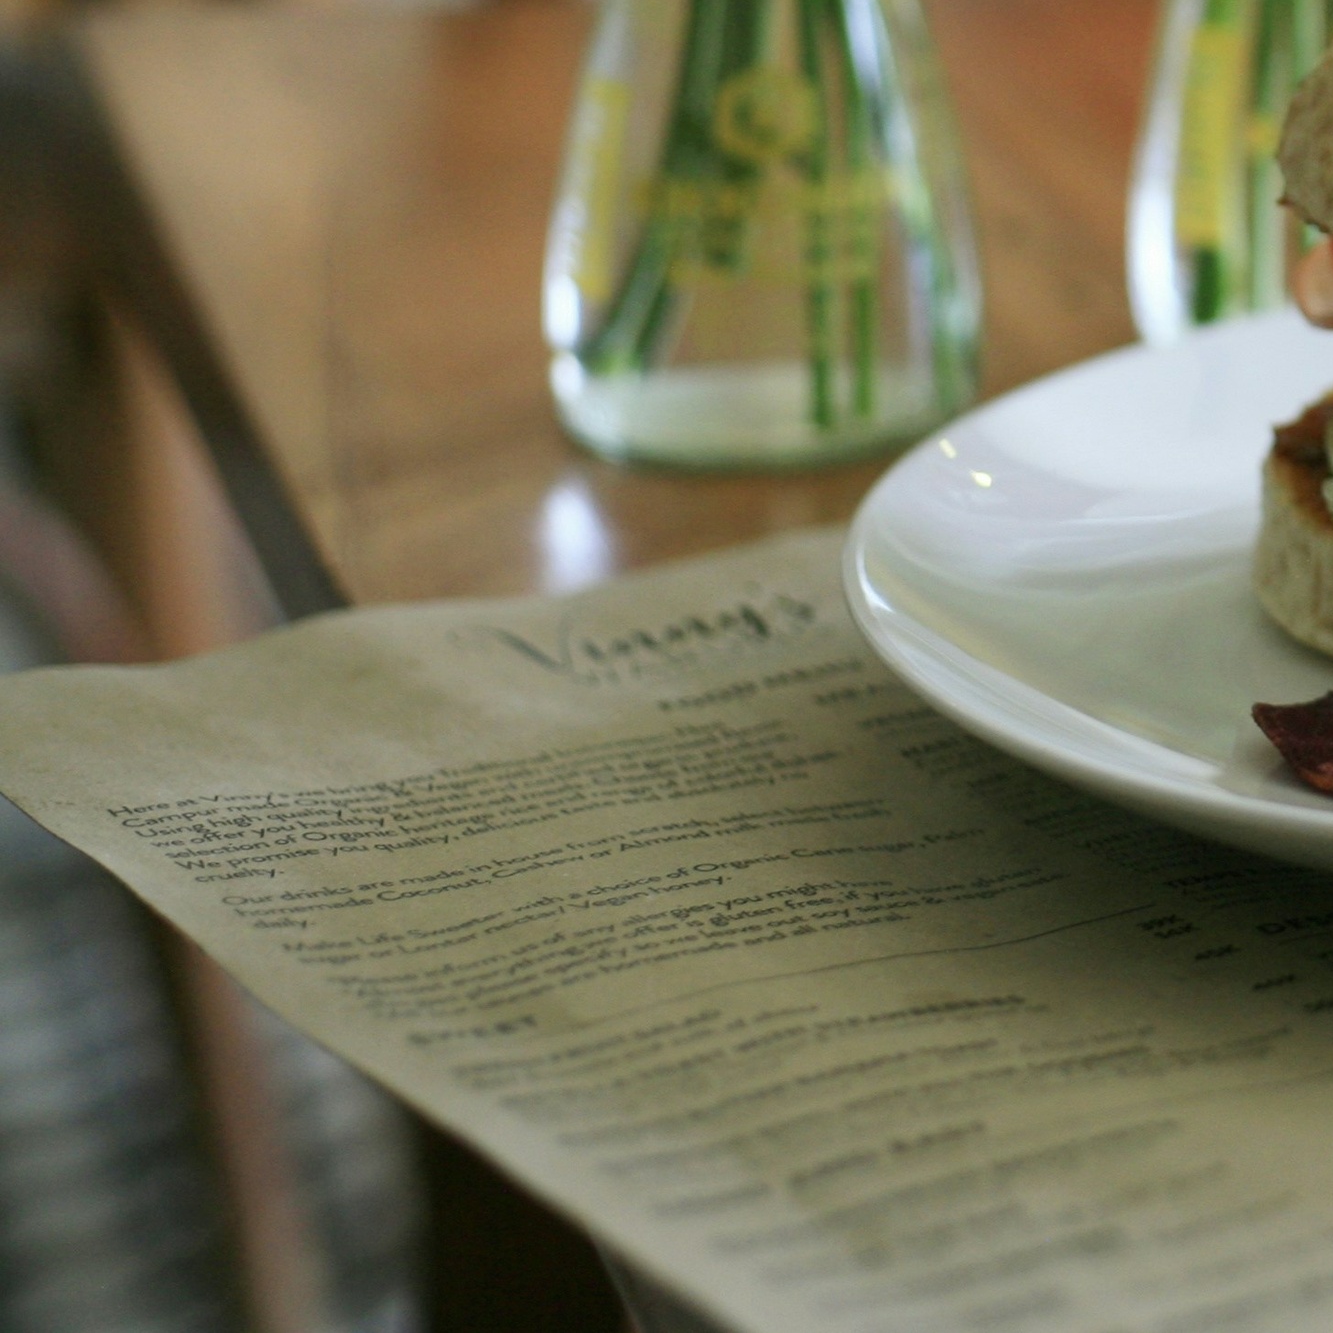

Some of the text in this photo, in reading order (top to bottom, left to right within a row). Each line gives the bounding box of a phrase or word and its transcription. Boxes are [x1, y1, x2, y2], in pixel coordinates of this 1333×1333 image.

[105, 802, 170, 818] Here
[175, 797, 199, 808] at
[197, 790, 290, 809] Vinny's
[120, 807, 218, 828] Campur
[225, 800, 290, 812] made
[133, 822, 204, 838] Using
[205, 813, 262, 832] high
[266, 807, 342, 823] quality
[149, 839, 185, 848] we
[189, 830, 245, 844] offer
[250, 824, 295, 839] you
[295, 810, 385, 836] healthy
[163, 840, 271, 859] selection
[273, 833, 297, 846] of
[300, 821, 393, 842] Organic
[173, 858, 221, 871] We
[225, 848, 320, 868] promise
[323, 844, 369, 857] you
[373, 833, 460, 853] quality,
[220, 894, 273, 906] Our
[278, 885, 354, 901] drinks
[357, 880, 394, 891] are
[398, 869, 465, 885] made
[467, 863, 492, 873] in
[490, 847, 563, 867] house
[564, 833, 626, 851] from
[193, 867, 285, 883] cruelty.
[232, 896, 374, 918] homemade
[375, 877, 492, 902] Coconut,
[490, 854, 584, 879] Cashew
[588, 848, 612, 859] or
[619, 828, 711, 852] Almond
[355, 931, 405, 945] Life
[405, 910, 505, 939] Sweeter
[510, 895, 564, 913] with
[567, 891, 582, 900] a
[585, 875, 662, 896] choice
[665, 866, 689, 879] of
[691, 852, 790, 873] Organic
[789, 846, 855, 858] Cane
[622, 922, 678, 939] offer
[685, 919, 705, 928] is
[708, 906, 783, 927] gluten
[783, 890, 844, 910] free,
[838, 889, 860, 903] if
[864, 889, 909, 901] you
[251, 916, 316, 930] daily.
[368, 948, 392, 959] or
[396, 932, 477, 955] Lontar
[566, 890, 649, 910] Vegan
[646, 874, 732, 895] honey.
[510, 942, 539, 956] us
[541, 931, 566, 945] of
[572, 923, 615, 938] any
[621, 902, 715, 927] allergies
[715, 894, 763, 911] you
[765, 879, 837, 899] might
[833, 878, 893, 895] have
[633, 941, 660, 951] so
[664, 934, 698, 945] we
[697, 924, 763, 939] leave
[765, 914, 806, 927] out
[810, 907, 850, 919] soy
[854, 900, 920, 913] sauce
[597, 941, 738, 974] homemade
[742, 929, 787, 946] and
